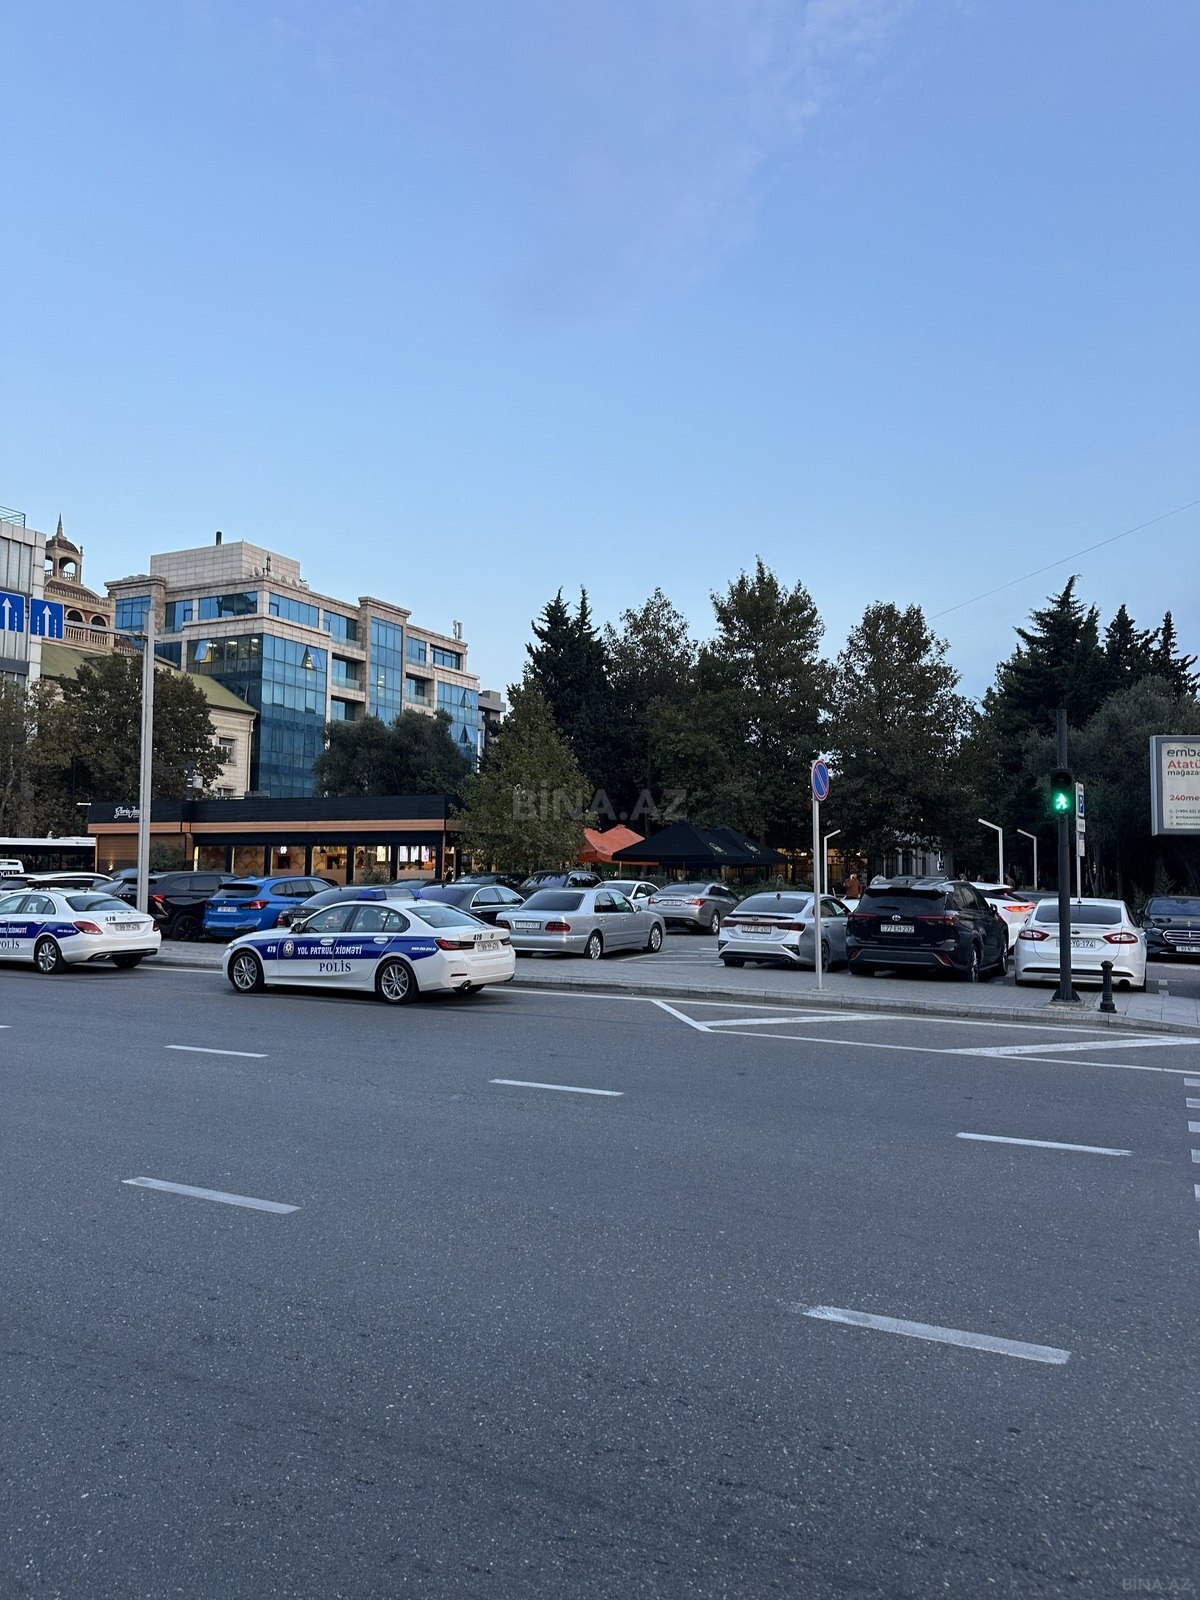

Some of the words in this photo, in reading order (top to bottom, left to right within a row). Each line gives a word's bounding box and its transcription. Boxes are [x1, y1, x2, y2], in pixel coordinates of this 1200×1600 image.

[1168, 760, 1200, 769] Atatü
[0, 939, 20, 949] OLİS
[297, 946, 308, 955] YOL
[310, 946, 333, 954] PATRUL
[319, 960, 351, 972] POLİS
